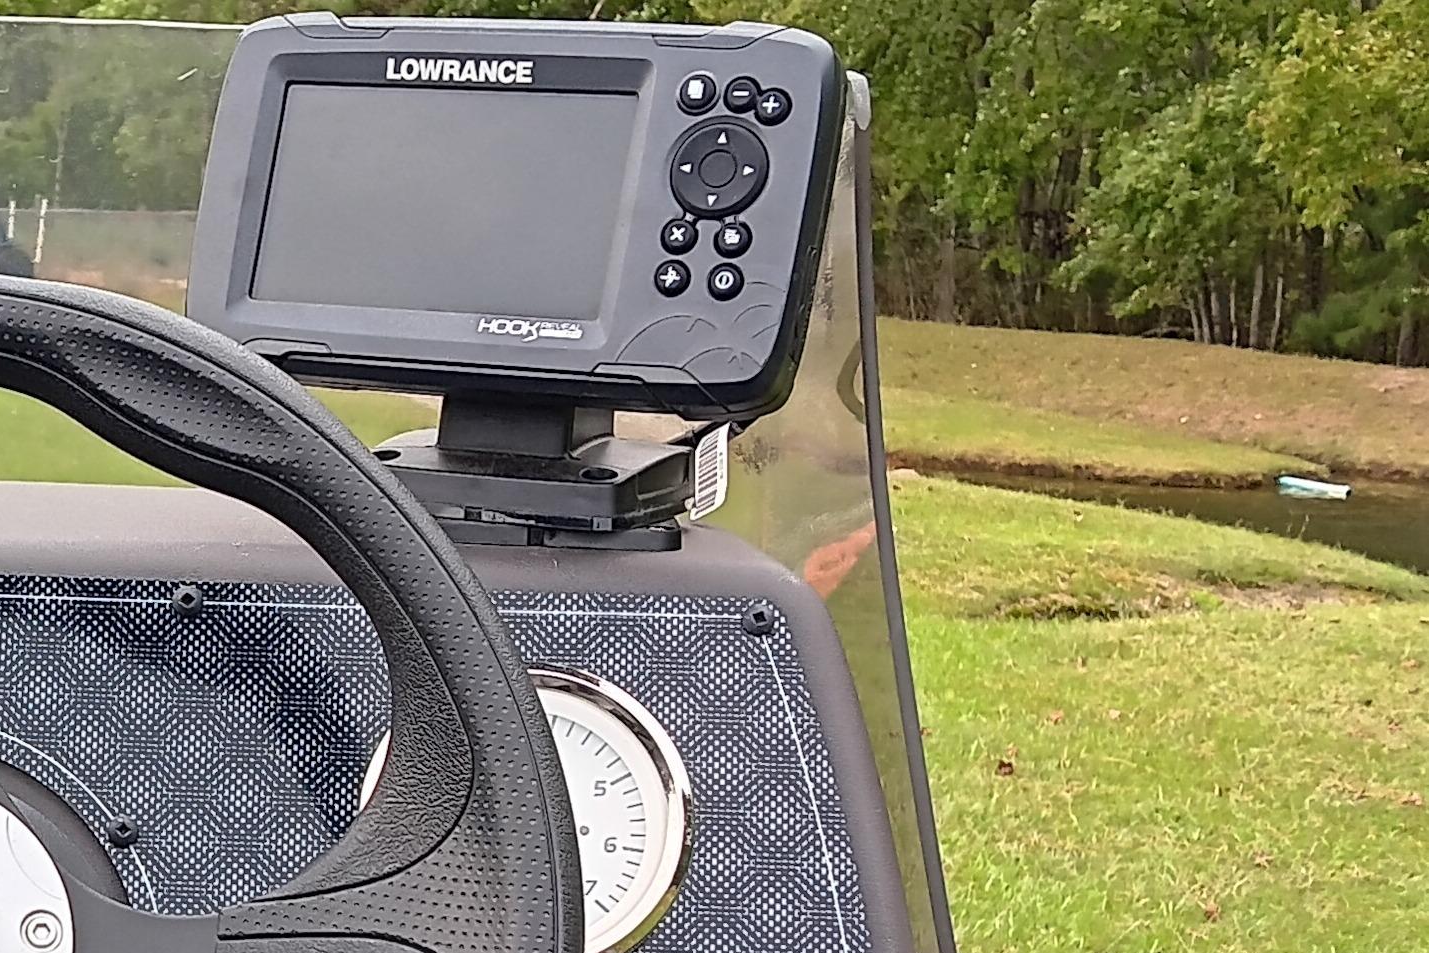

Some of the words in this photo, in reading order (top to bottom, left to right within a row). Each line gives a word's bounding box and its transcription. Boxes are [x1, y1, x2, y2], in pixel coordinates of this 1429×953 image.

[385, 57, 534, 84] LOWRANCE
[477, 318, 540, 342] HOOK
[593, 780, 607, 797] 5
[604, 837, 617, 853] 6
[585, 880, 598, 896] 7
